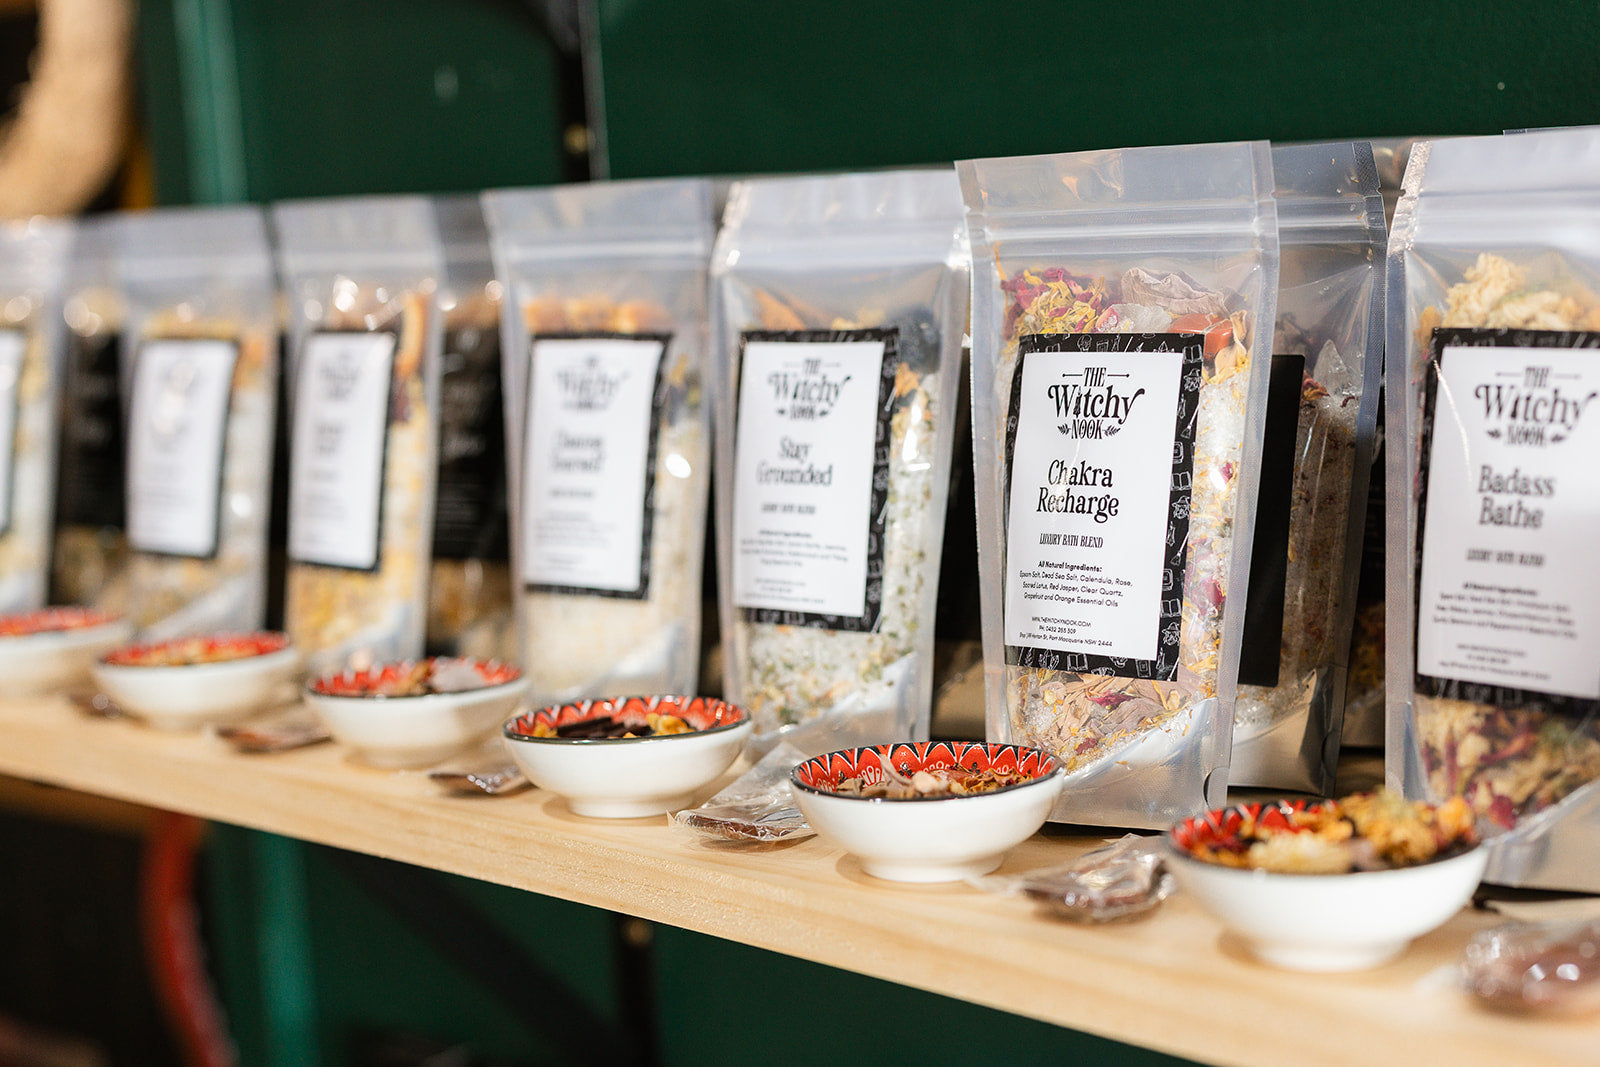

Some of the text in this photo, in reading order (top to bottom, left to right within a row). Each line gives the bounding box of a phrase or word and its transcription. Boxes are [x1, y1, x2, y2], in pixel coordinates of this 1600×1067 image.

[767, 373, 853, 408] Witchy
[1084, 368, 1106, 388] THE
[1048, 383, 1144, 424] Witchy
[1474, 383, 1598, 430] Witchy
[1071, 419, 1104, 440] NOOK
[779, 436, 812, 465] Stay
[756, 463, 834, 488] Grounded
[1048, 460, 1113, 488] Chakra
[1478, 465, 1556, 498] Badass
[1036, 486, 1120, 524] Recharge
[1478, 498, 1544, 529] Bathe
[1040, 533, 1104, 548] LUXURY BATH BLEND
[1045, 561, 1064, 569] Natural
[1065, 562, 1102, 572] Ingredients:
[1049, 582, 1058, 590] Red
[1060, 583, 1079, 593] Jasper,
[1080, 586, 1098, 594] Clear
[1099, 588, 1123, 597] Quartz,
[1066, 574, 1078, 582] Salt,
[1080, 574, 1114, 585] Calendula,
[1115, 578, 1133, 586] Rose,
[1054, 594, 1075, 604] Orange
[1077, 596, 1104, 606] Essential
